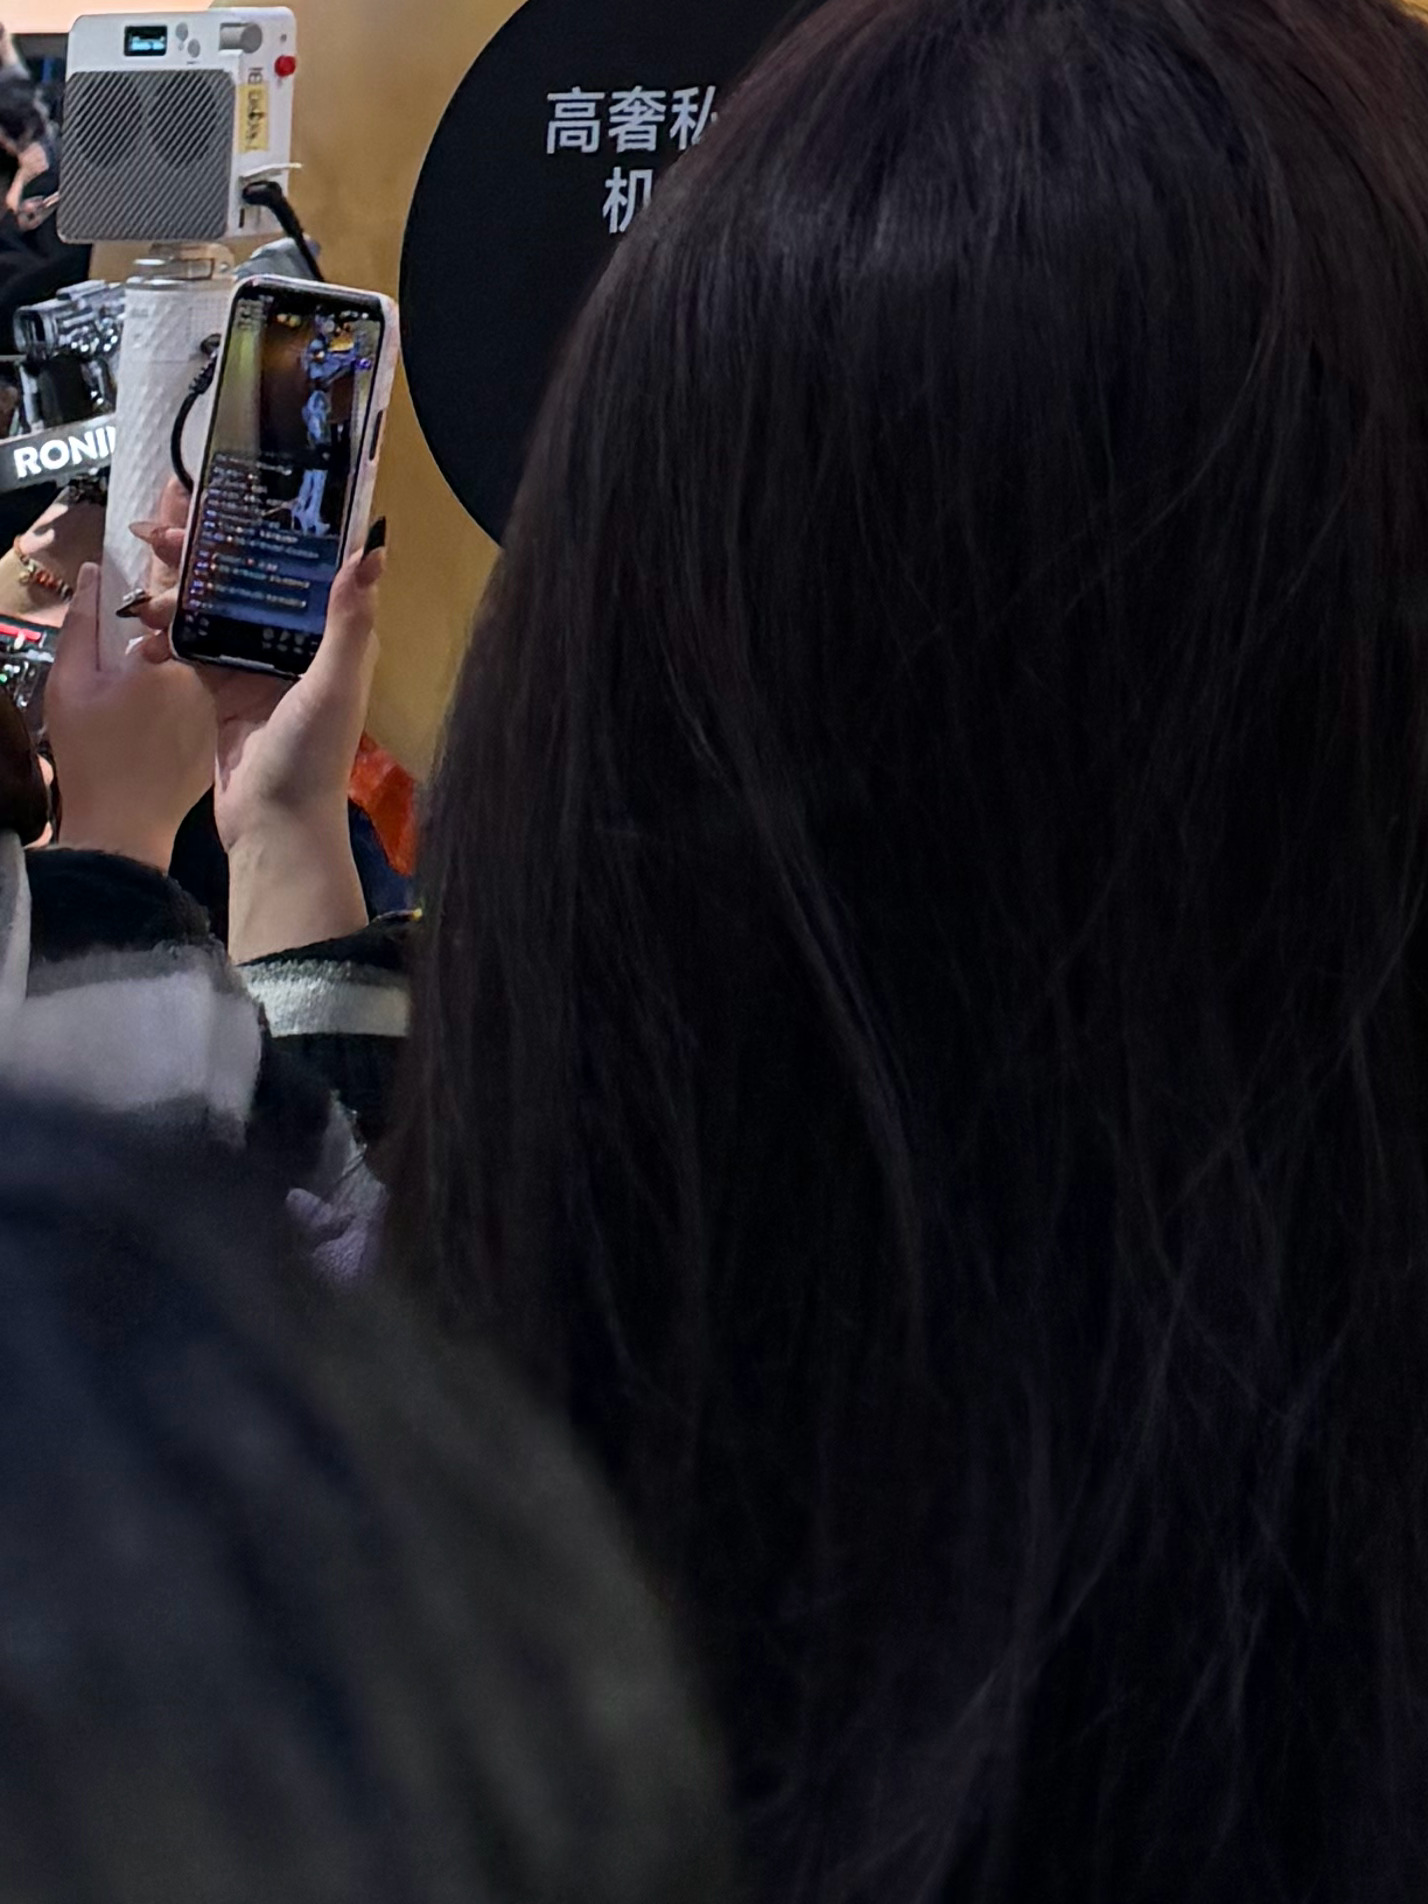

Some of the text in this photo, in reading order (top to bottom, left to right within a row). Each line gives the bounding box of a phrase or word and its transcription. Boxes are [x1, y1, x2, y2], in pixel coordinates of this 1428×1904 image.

[547, 85, 717, 154] 高奢私
[602, 166, 653, 233] 机
